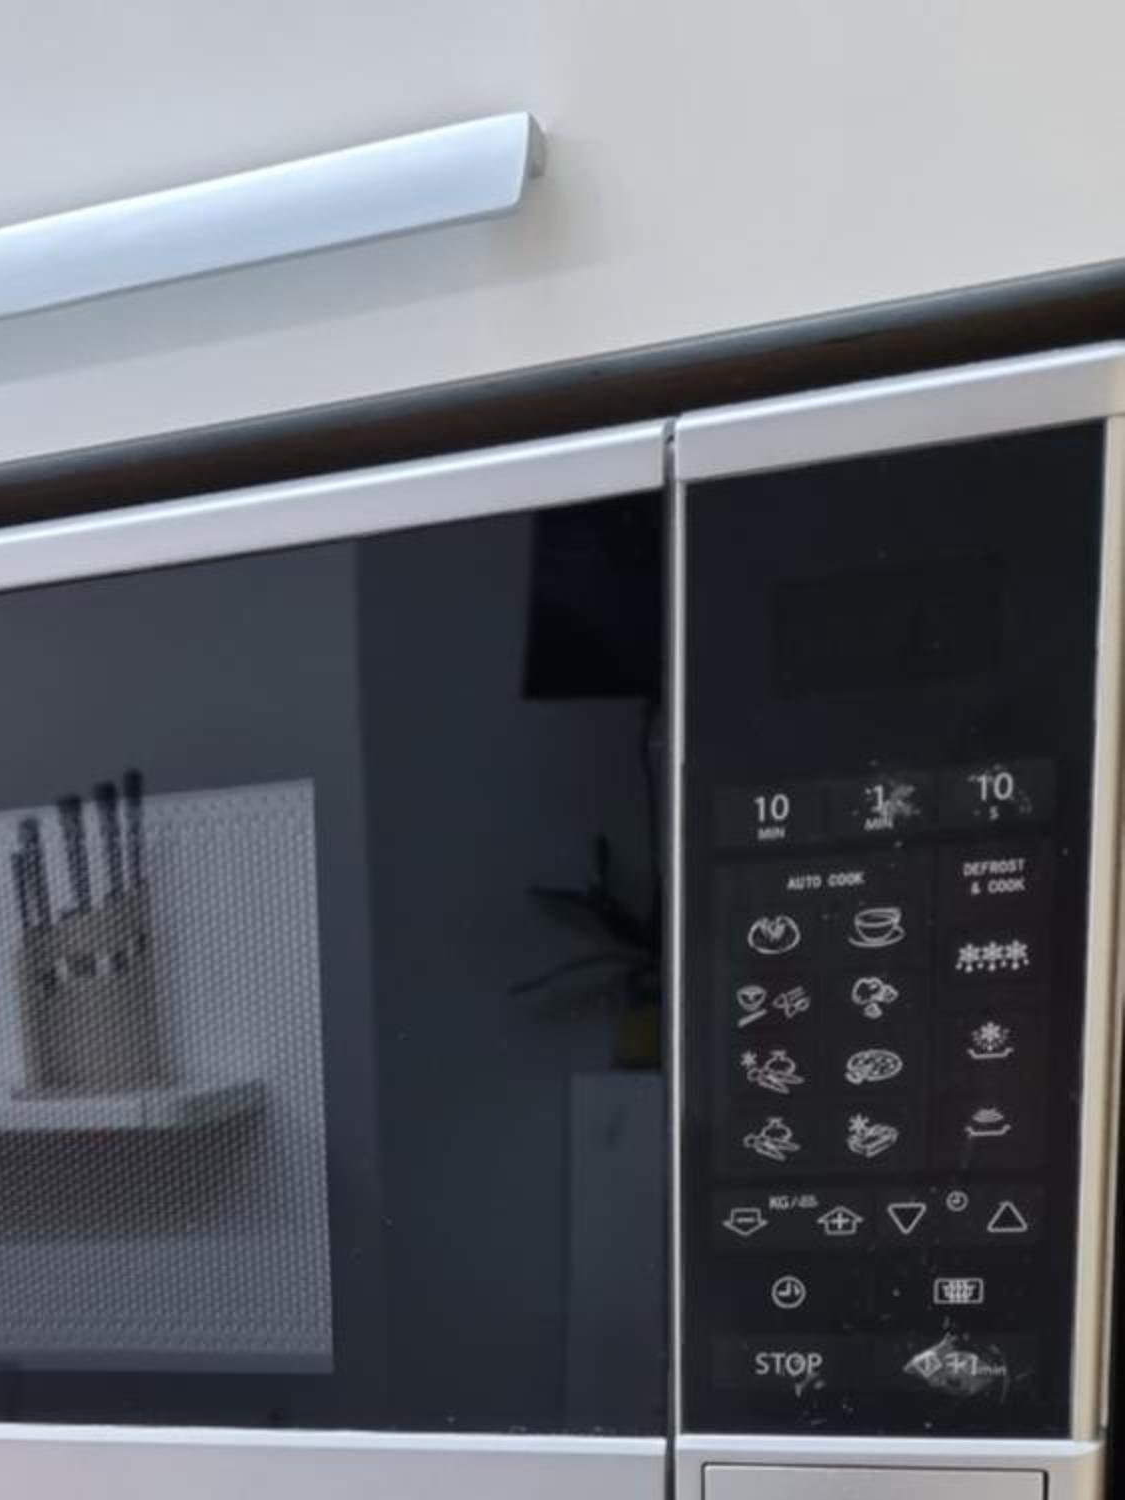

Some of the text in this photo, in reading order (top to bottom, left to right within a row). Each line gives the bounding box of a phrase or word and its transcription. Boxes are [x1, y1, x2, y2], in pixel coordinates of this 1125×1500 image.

[975, 772, 1014, 801] 10
[754, 794, 790, 822] 10
[757, 827, 786, 841] MIN
[962, 858, 1026, 877] DEFROST
[787, 871, 866, 890] AUTO COOK
[971, 878, 1026, 895] & COOK
[754, 1351, 824, 1376] STOP
